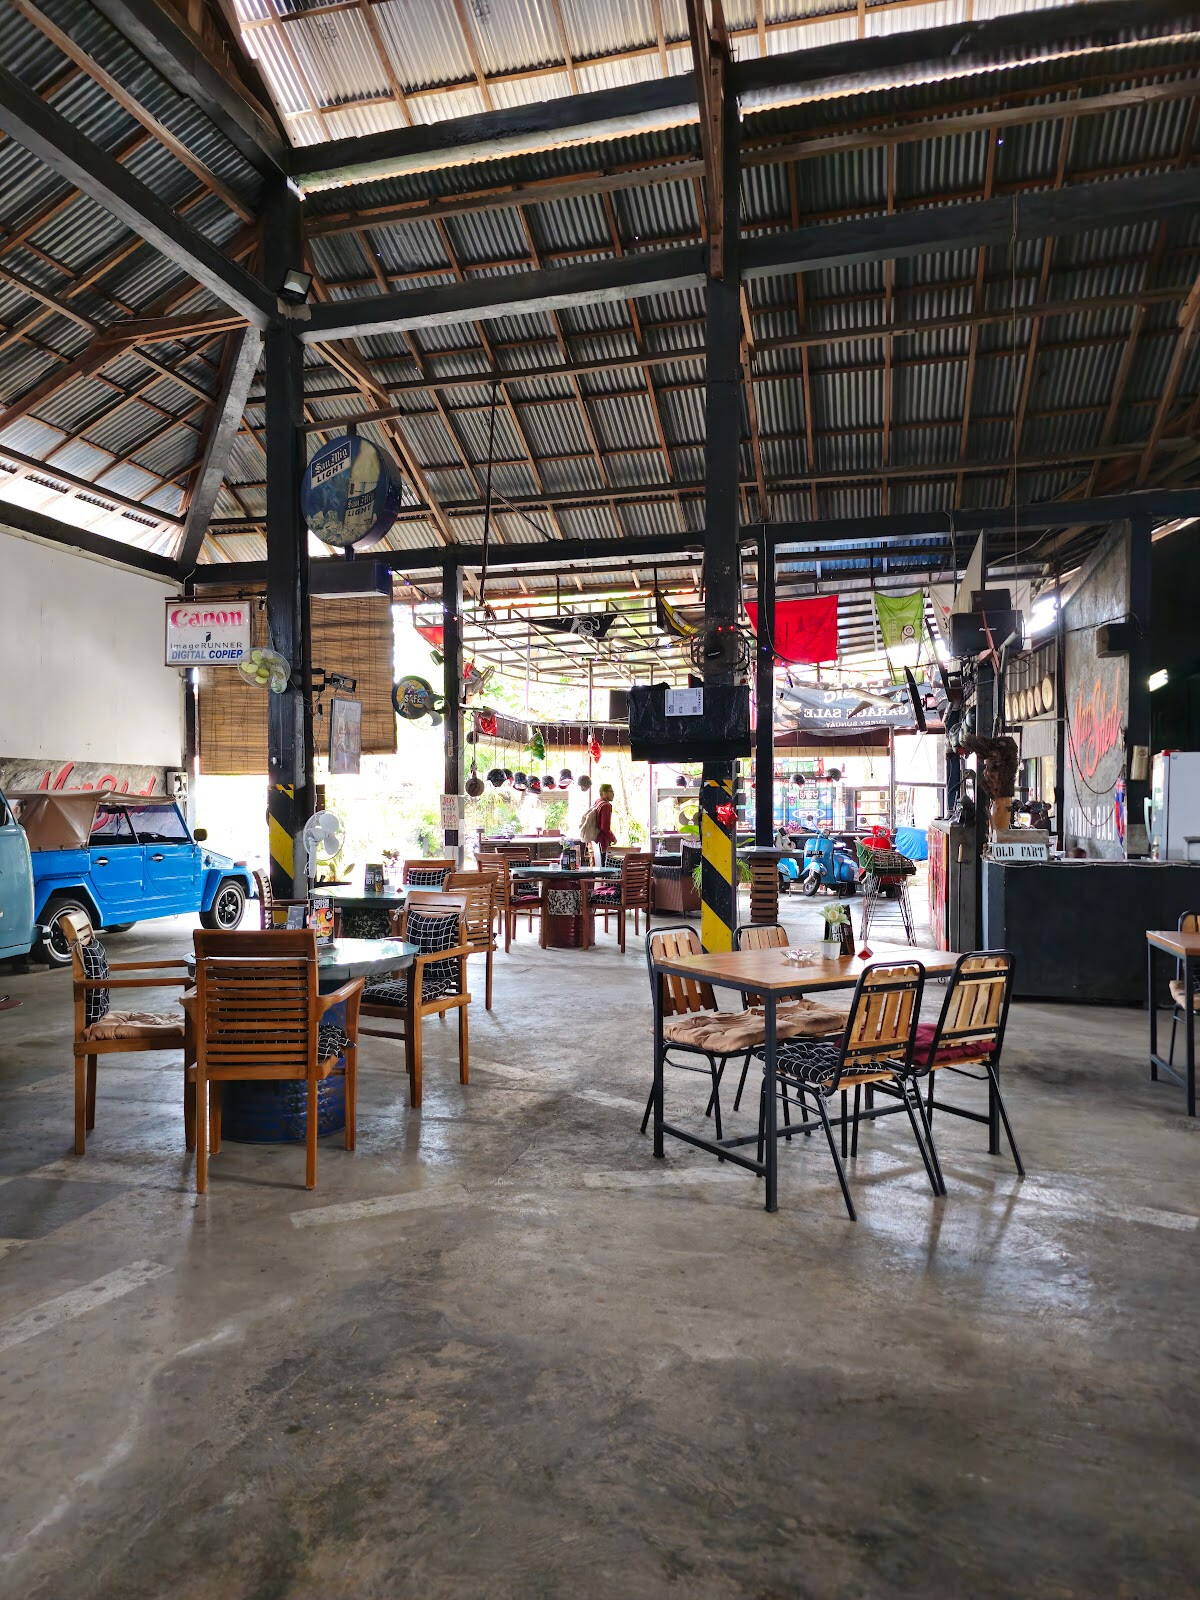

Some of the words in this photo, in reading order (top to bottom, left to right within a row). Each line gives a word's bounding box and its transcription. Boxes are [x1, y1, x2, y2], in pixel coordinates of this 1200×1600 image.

[314, 459, 331, 475] San
[331, 449, 348, 465] Mig
[317, 462, 345, 482] LIGHT
[348, 504, 372, 517] LIGHT
[171, 609, 242, 628] Canon
[170, 641, 243, 650] imageRUNNER
[171, 650, 206, 659] DIGITAL
[208, 649, 243, 659] COPIER
[1085, 665, 1123, 778] Shed
[995, 846, 1015, 857] OLD
[1021, 846, 1044, 857] FART
